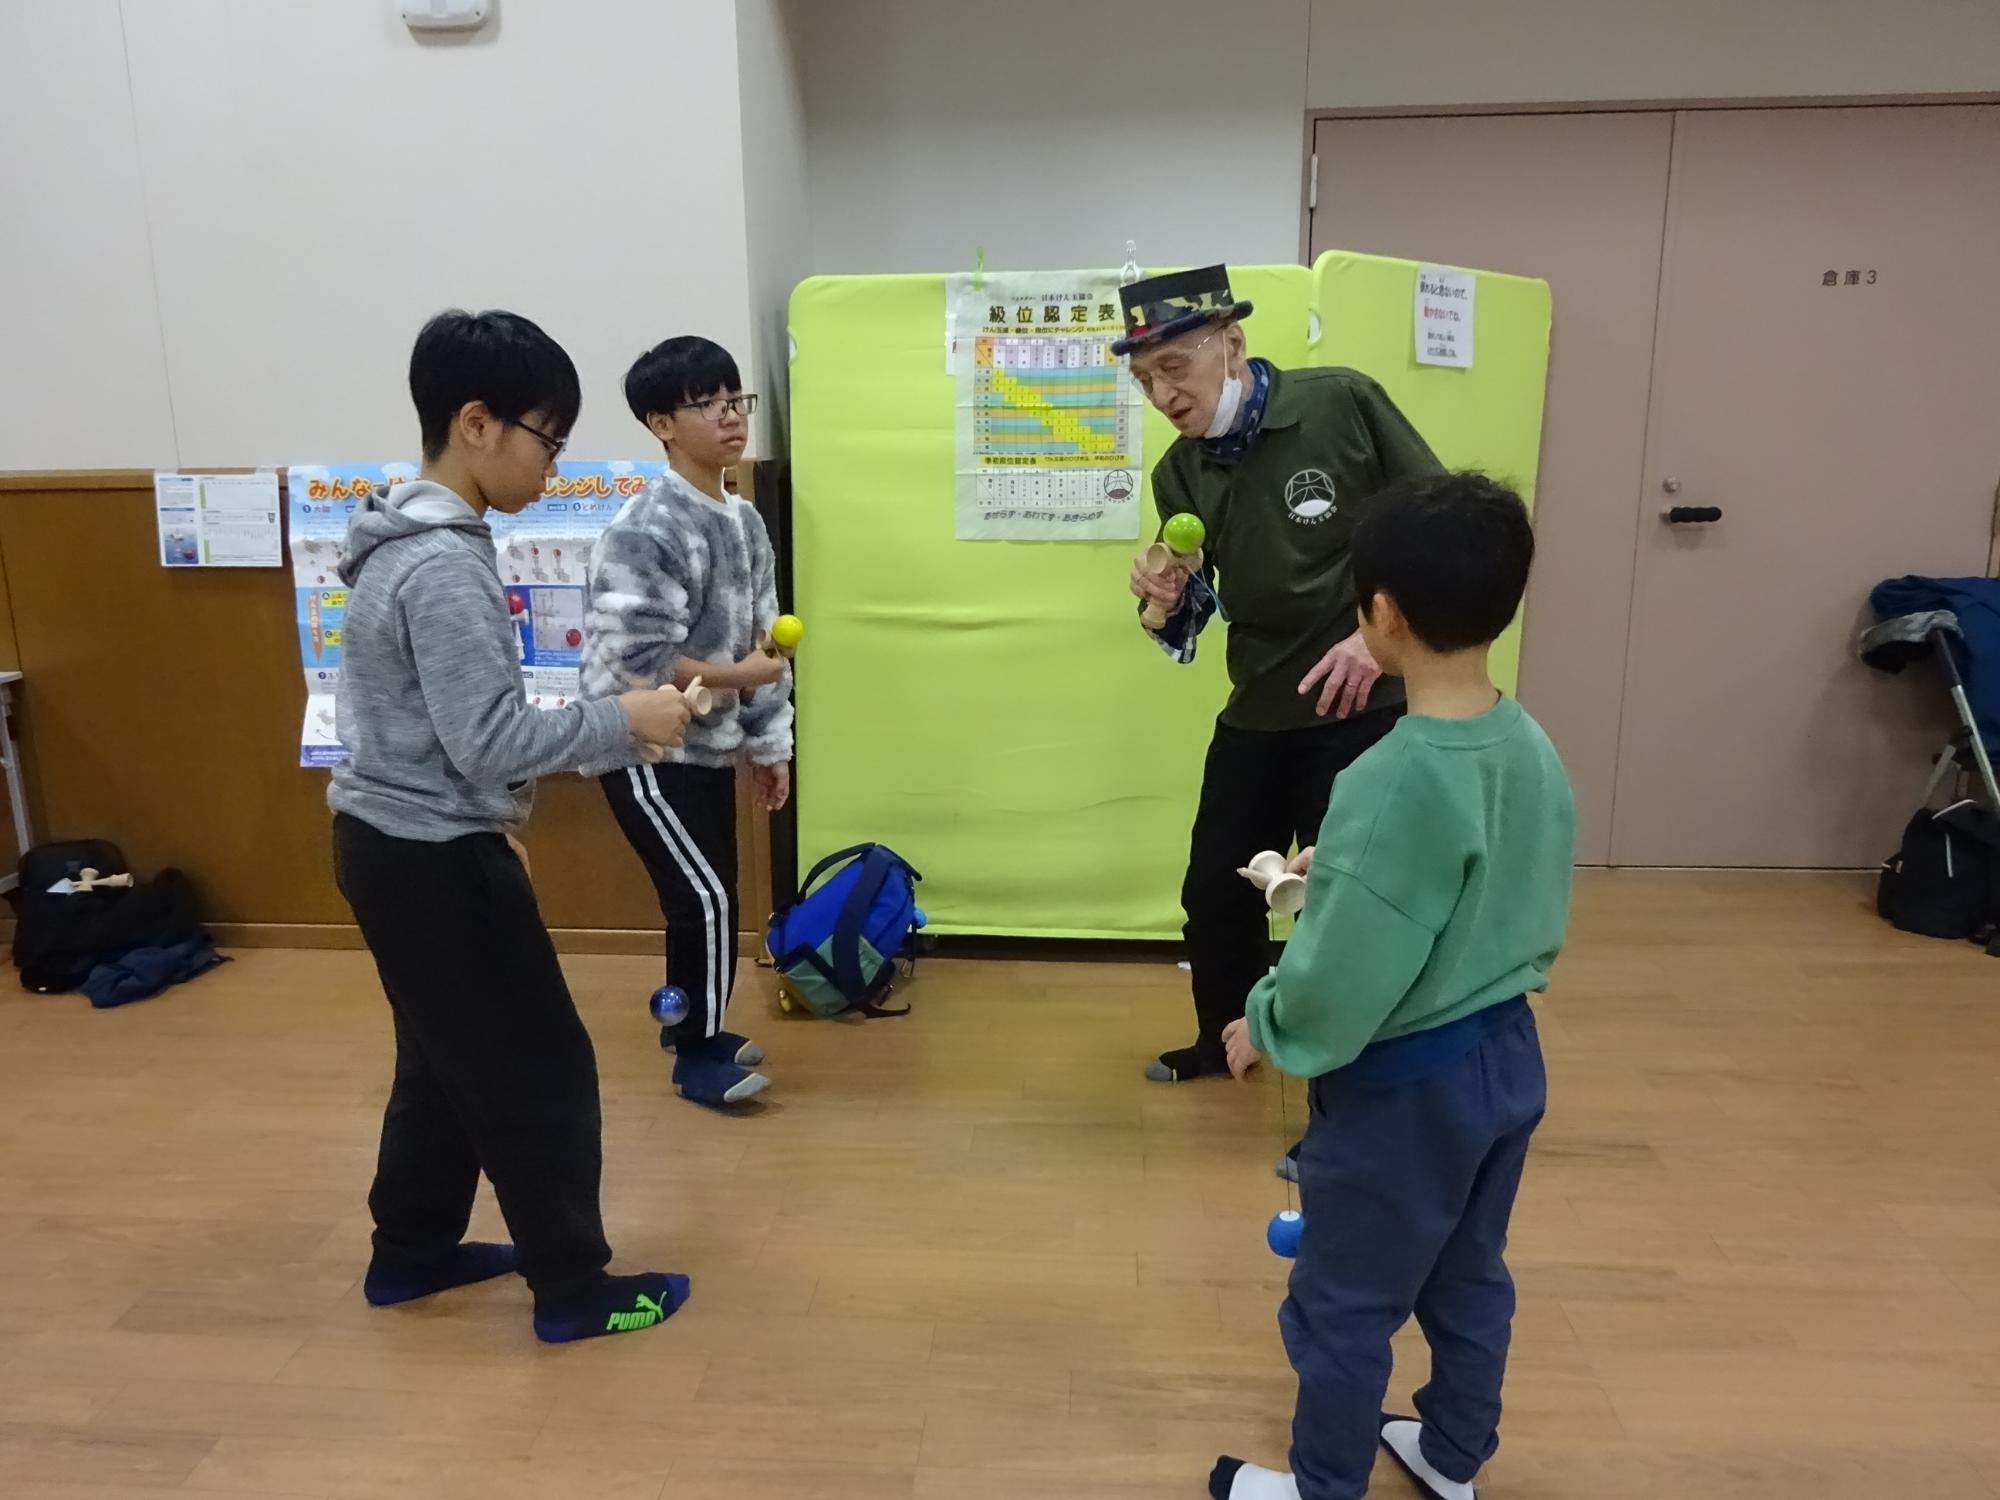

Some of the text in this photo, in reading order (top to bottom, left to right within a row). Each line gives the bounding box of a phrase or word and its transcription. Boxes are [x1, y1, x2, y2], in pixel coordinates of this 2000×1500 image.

[989, 304, 1115, 324] 級位認定表
[606, 1311, 656, 1331] PUMA
